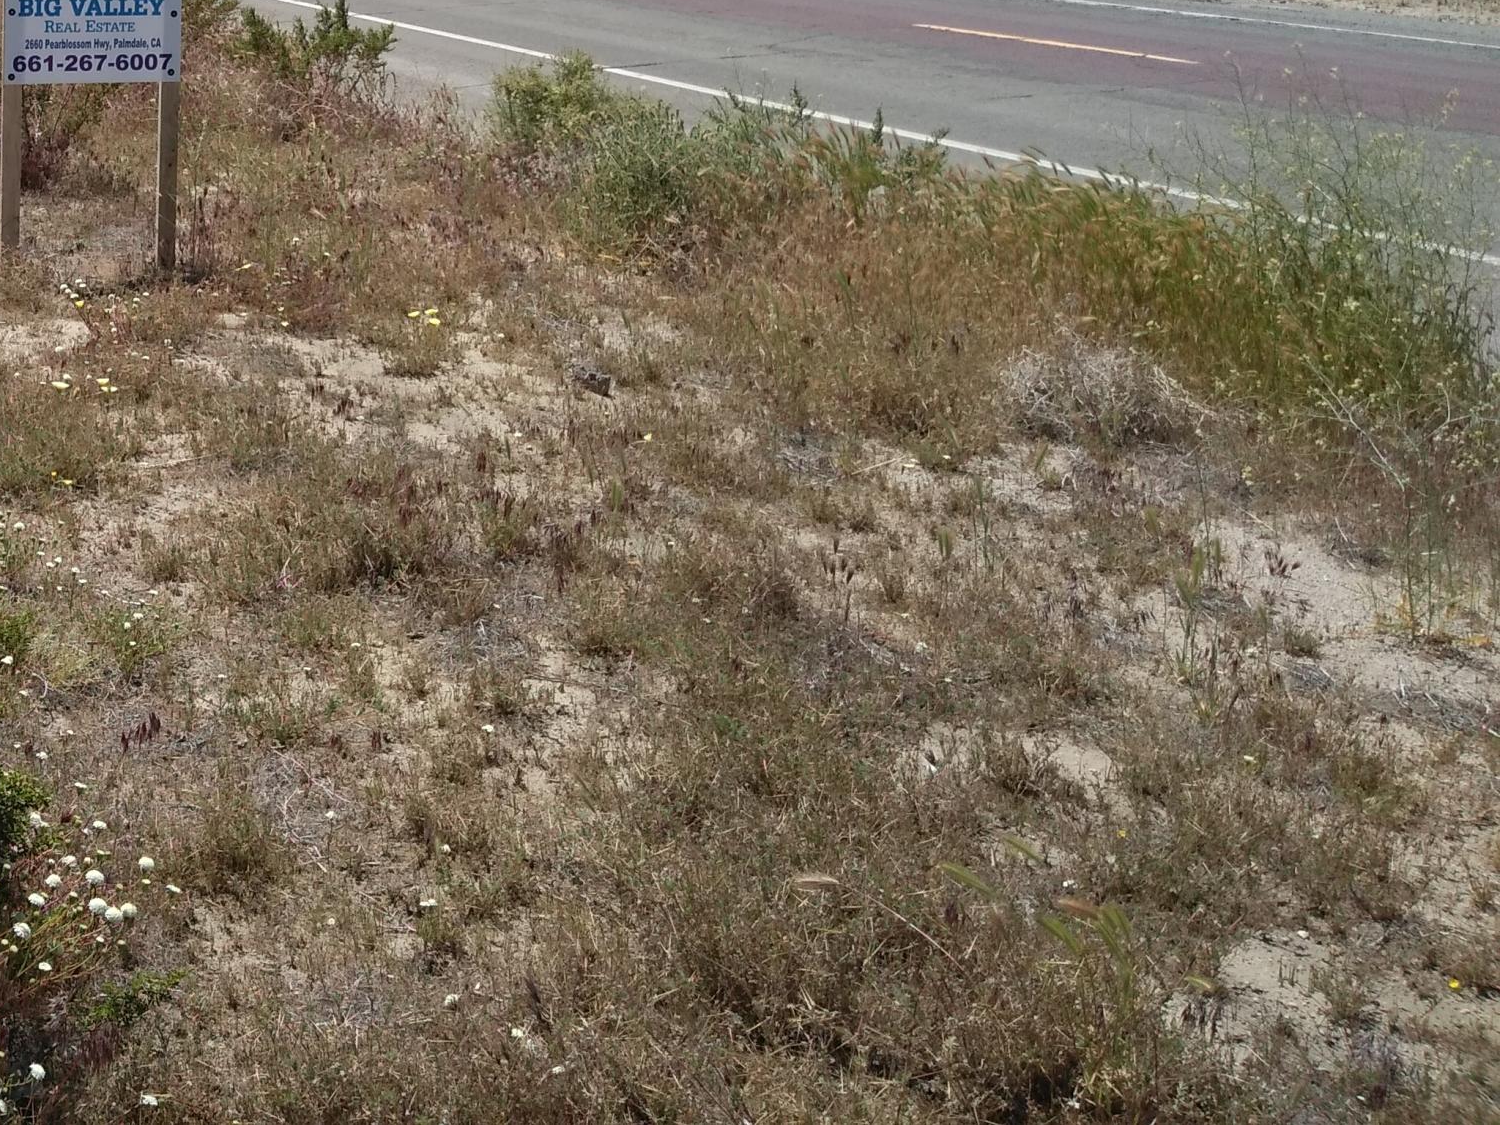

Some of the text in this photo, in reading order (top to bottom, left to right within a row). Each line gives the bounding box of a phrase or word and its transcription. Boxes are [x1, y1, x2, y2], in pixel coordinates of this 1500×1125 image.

[44, 20, 136, 33] REAL ESTATE
[25, 38, 161, 51] 2660 Pearblossom Hwy, Palmdale, CA
[13, 54, 173, 73] 661-267-6007
